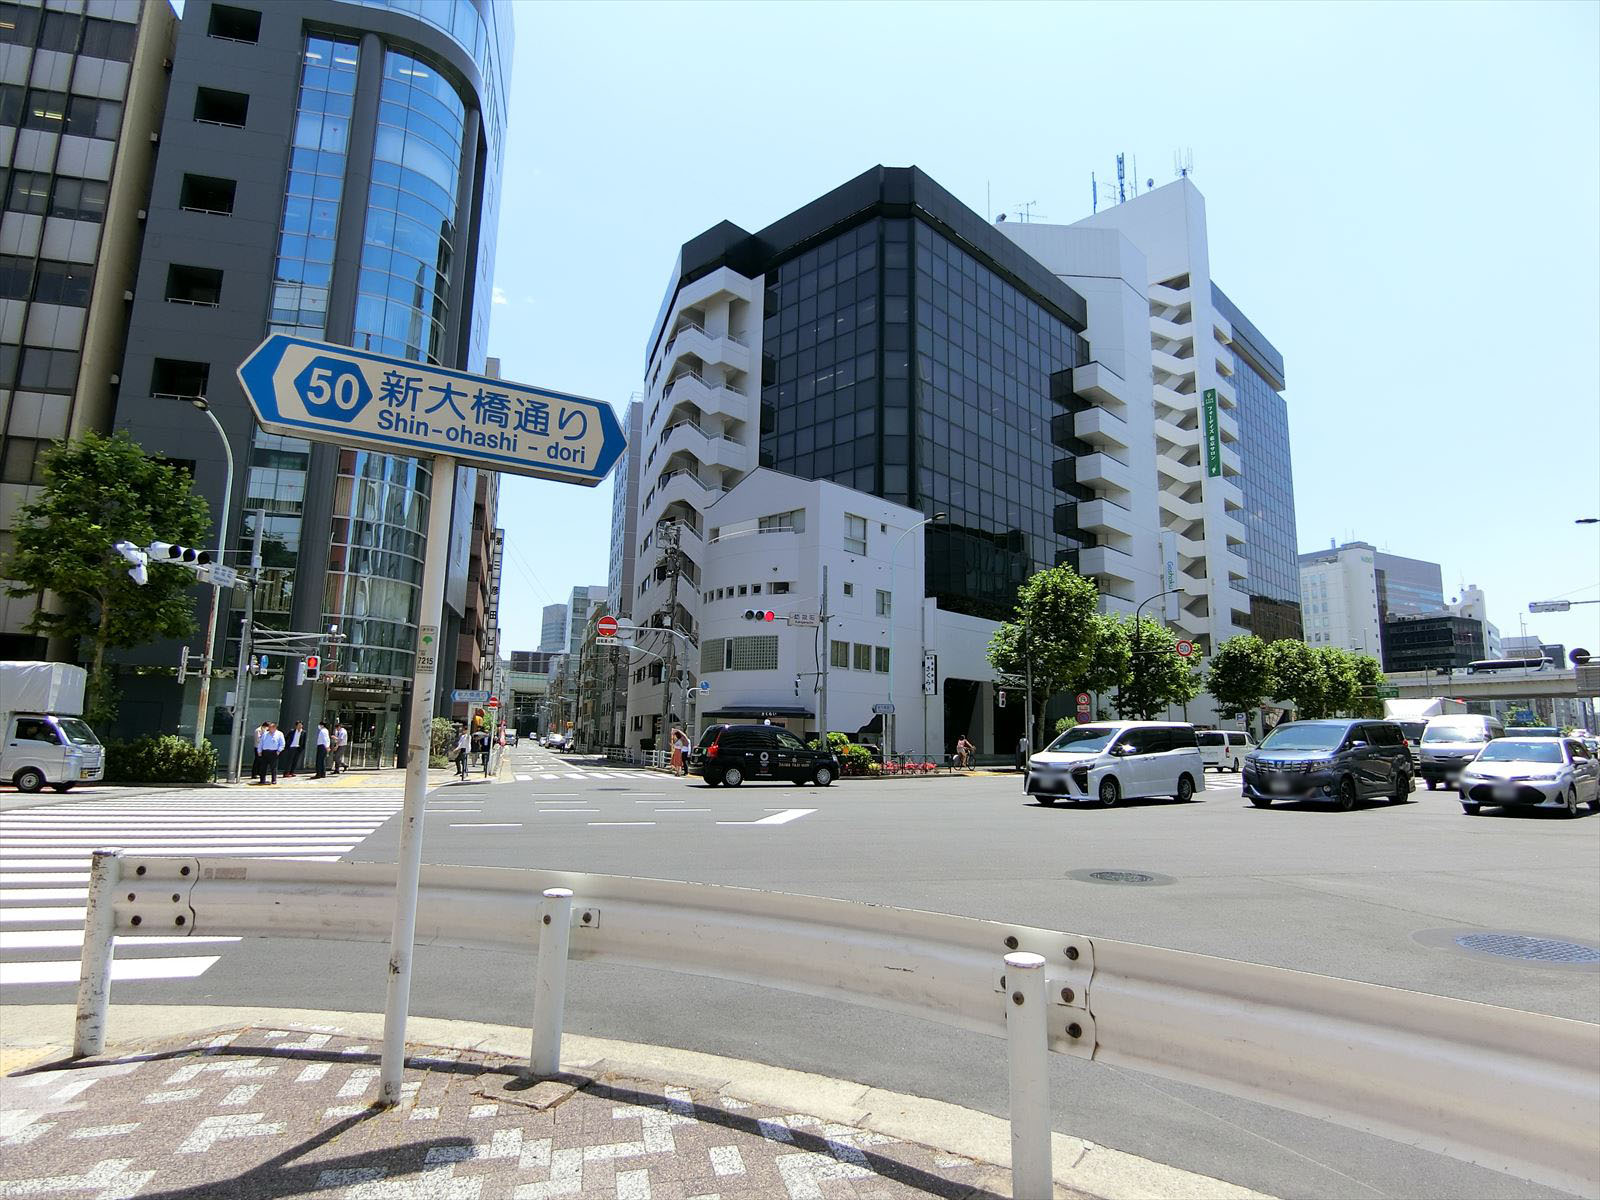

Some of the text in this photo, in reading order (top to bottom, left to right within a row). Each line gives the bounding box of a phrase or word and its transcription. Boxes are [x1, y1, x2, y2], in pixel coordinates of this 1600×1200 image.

[306, 368, 360, 410] 50
[378, 370, 588, 442] 新大橋通り
[417, 656, 434, 665] 7215
